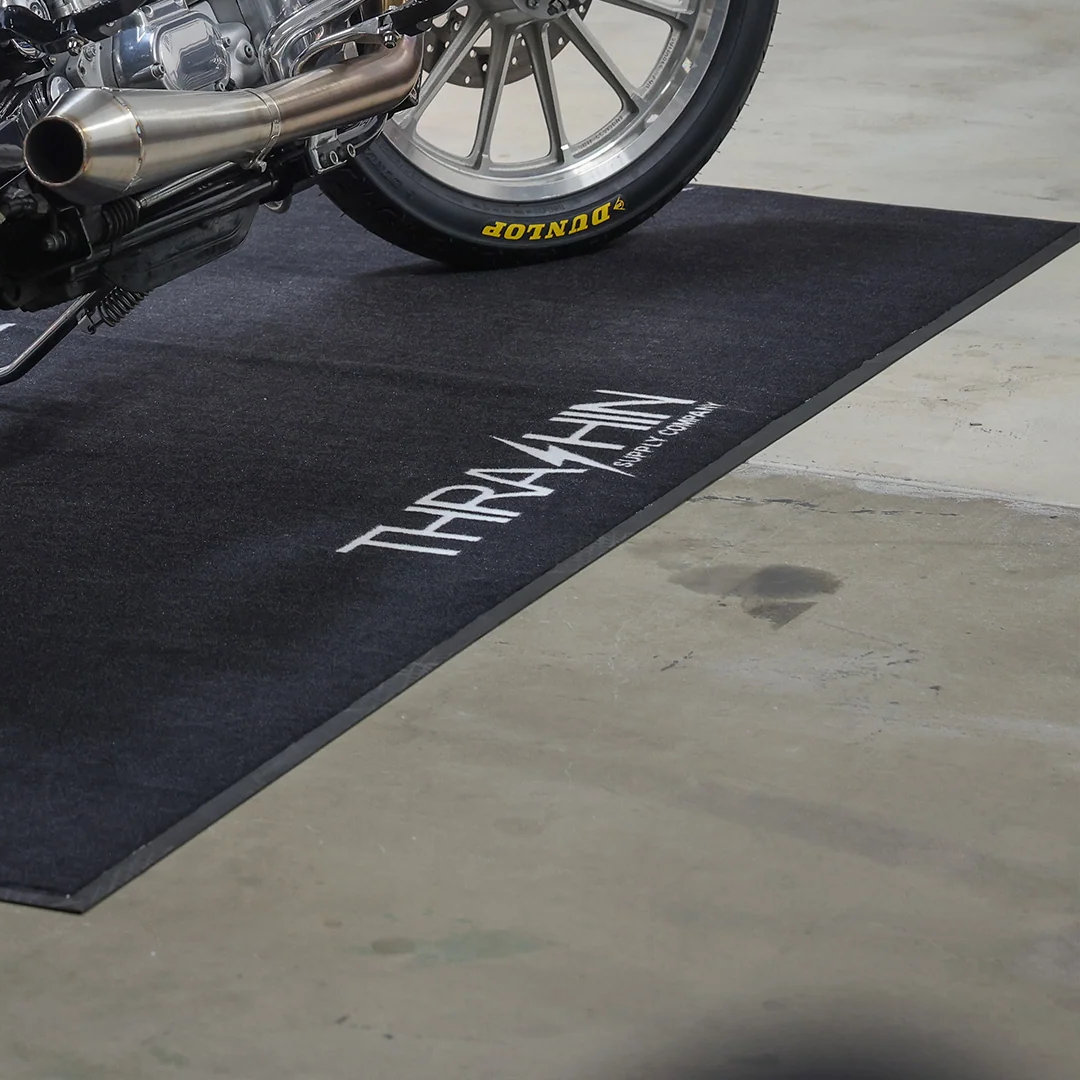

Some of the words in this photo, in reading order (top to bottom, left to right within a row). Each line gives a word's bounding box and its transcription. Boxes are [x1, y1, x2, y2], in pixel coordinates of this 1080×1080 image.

[482, 201, 612, 241] DUNLOP
[612, 433, 666, 469] SUPPLY
[658, 400, 725, 437] COMPANY
